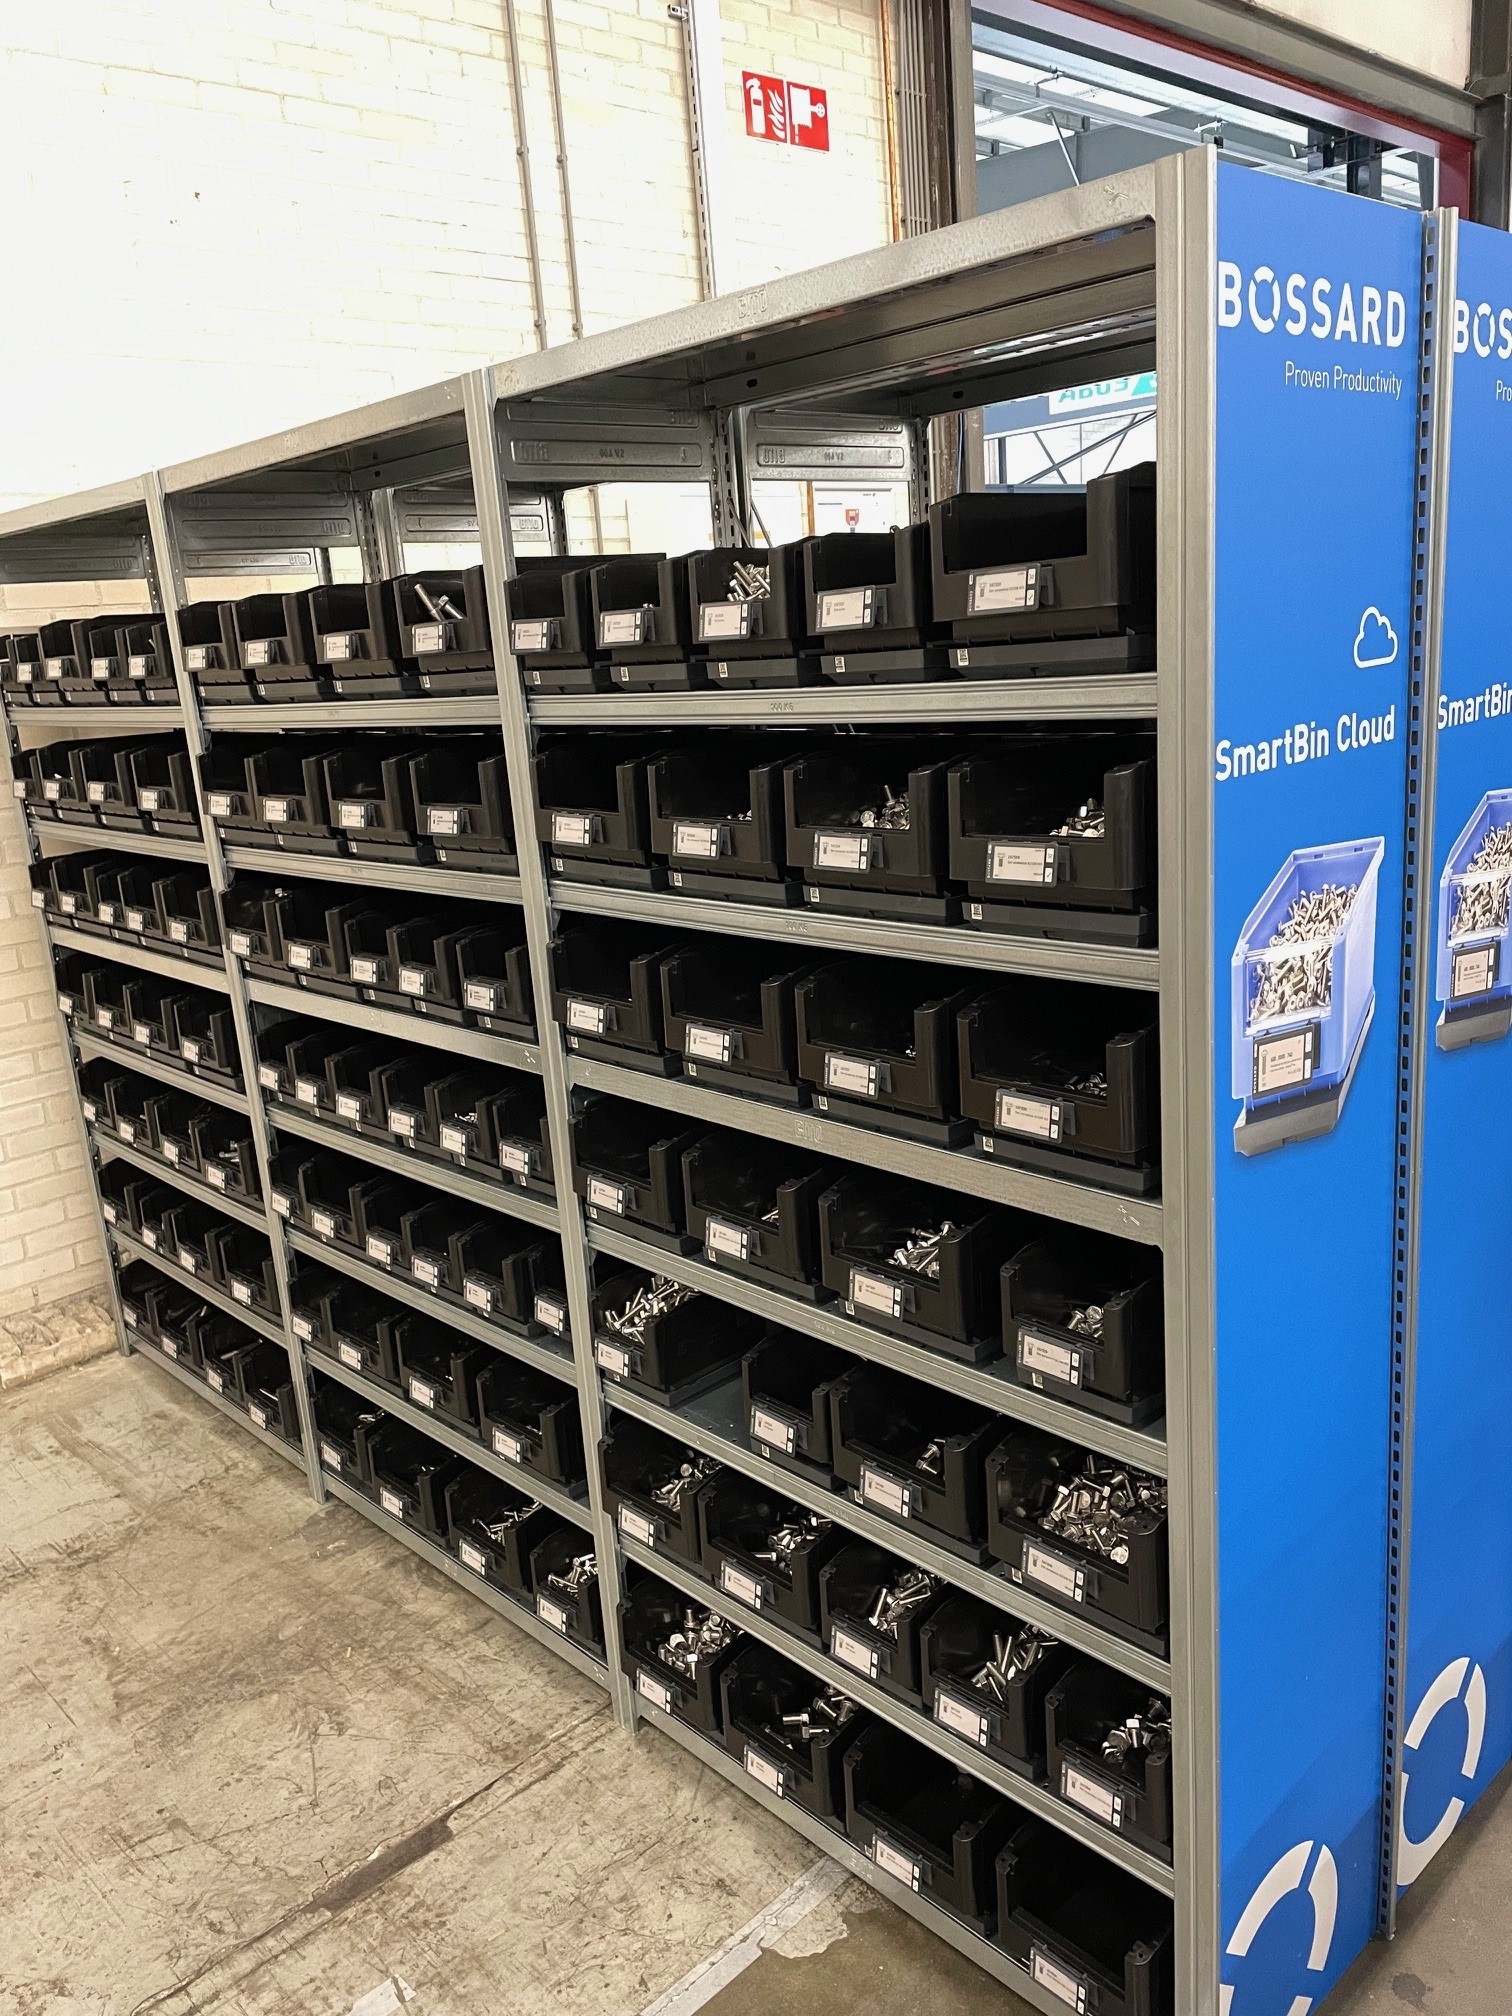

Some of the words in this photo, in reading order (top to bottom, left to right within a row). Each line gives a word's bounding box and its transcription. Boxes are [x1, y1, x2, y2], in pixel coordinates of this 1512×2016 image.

[1217, 261, 1406, 348] BOSSARD
[1286, 361, 1329, 389] Proven
[1334, 365, 1403, 401] Productivity
[1216, 722, 1329, 781] SmartBin
[1337, 705, 1396, 753] Cloud
